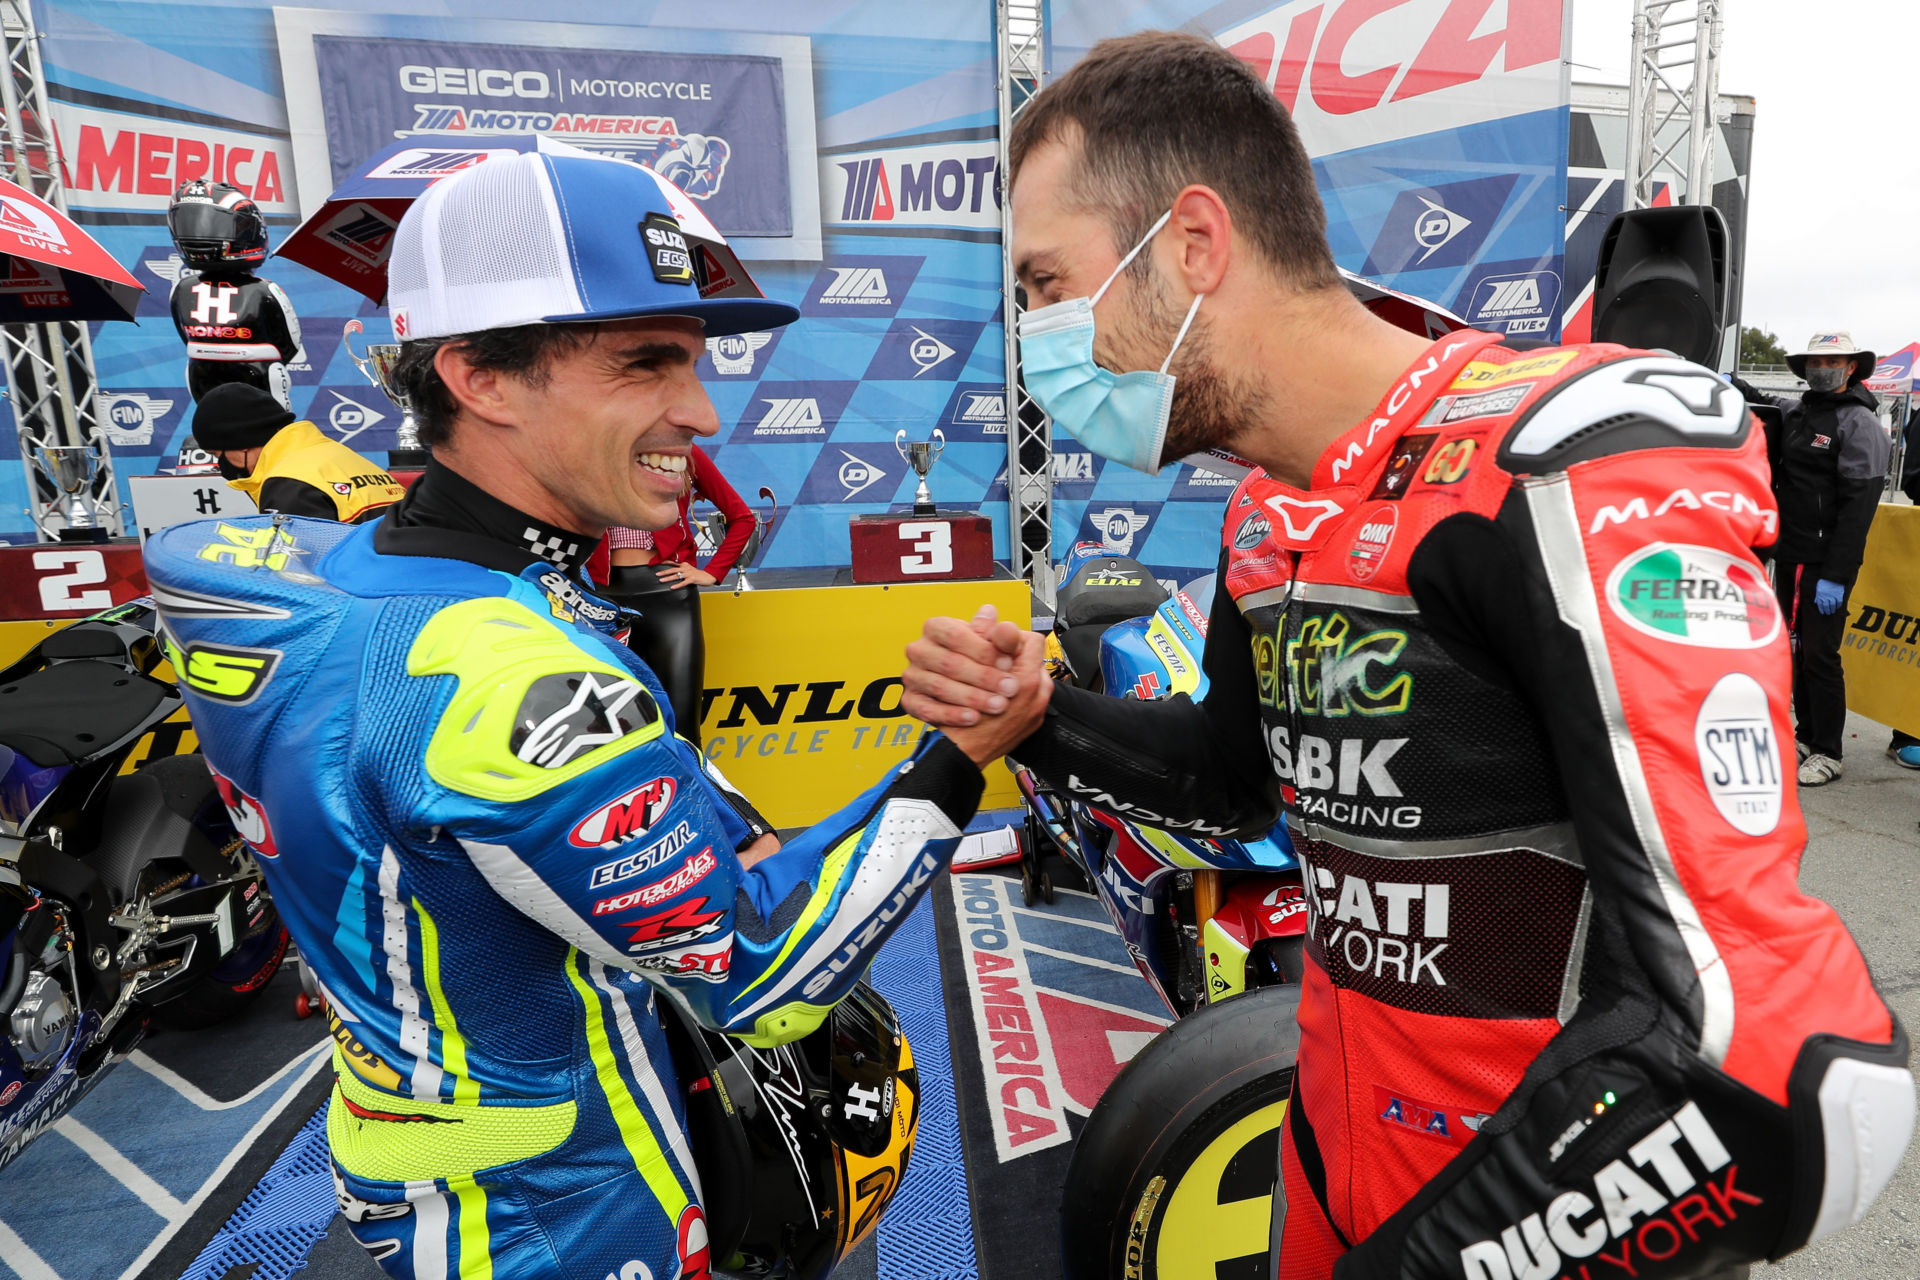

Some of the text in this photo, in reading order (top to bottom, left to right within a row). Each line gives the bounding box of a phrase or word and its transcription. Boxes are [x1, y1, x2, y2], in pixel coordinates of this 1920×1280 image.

[400, 65, 712, 101] GEICO MOTORCYCLE
[470, 110, 677, 136] MOTOAMERICA
[819, 296, 892, 305] MOTOAMERICA
[1477, 307, 1544, 319] MOTOAMERICA
[720, 337, 746, 355] FIM
[111, 405, 144, 425] FIM
[753, 427, 826, 436] MOTOAMERICA
[1332, 342, 1469, 484] MACNA
[898, 521, 953, 574] 3
[1107, 519, 1128, 536] FIM
[32, 550, 114, 611] 2
[1085, 578, 1143, 586] ELIAS
[1152, 632, 1188, 678] ECSTAR
[1251, 611, 1414, 718] eltic
[1262, 719, 1410, 797] SBK
[1705, 727, 1778, 786] STM
[589, 820, 698, 891] ECSTAR
[802, 851, 939, 1000] SUZUKI
[959, 876, 1058, 1149] MOTOAMERICA
[1598, 1165, 1763, 1277] YORK
